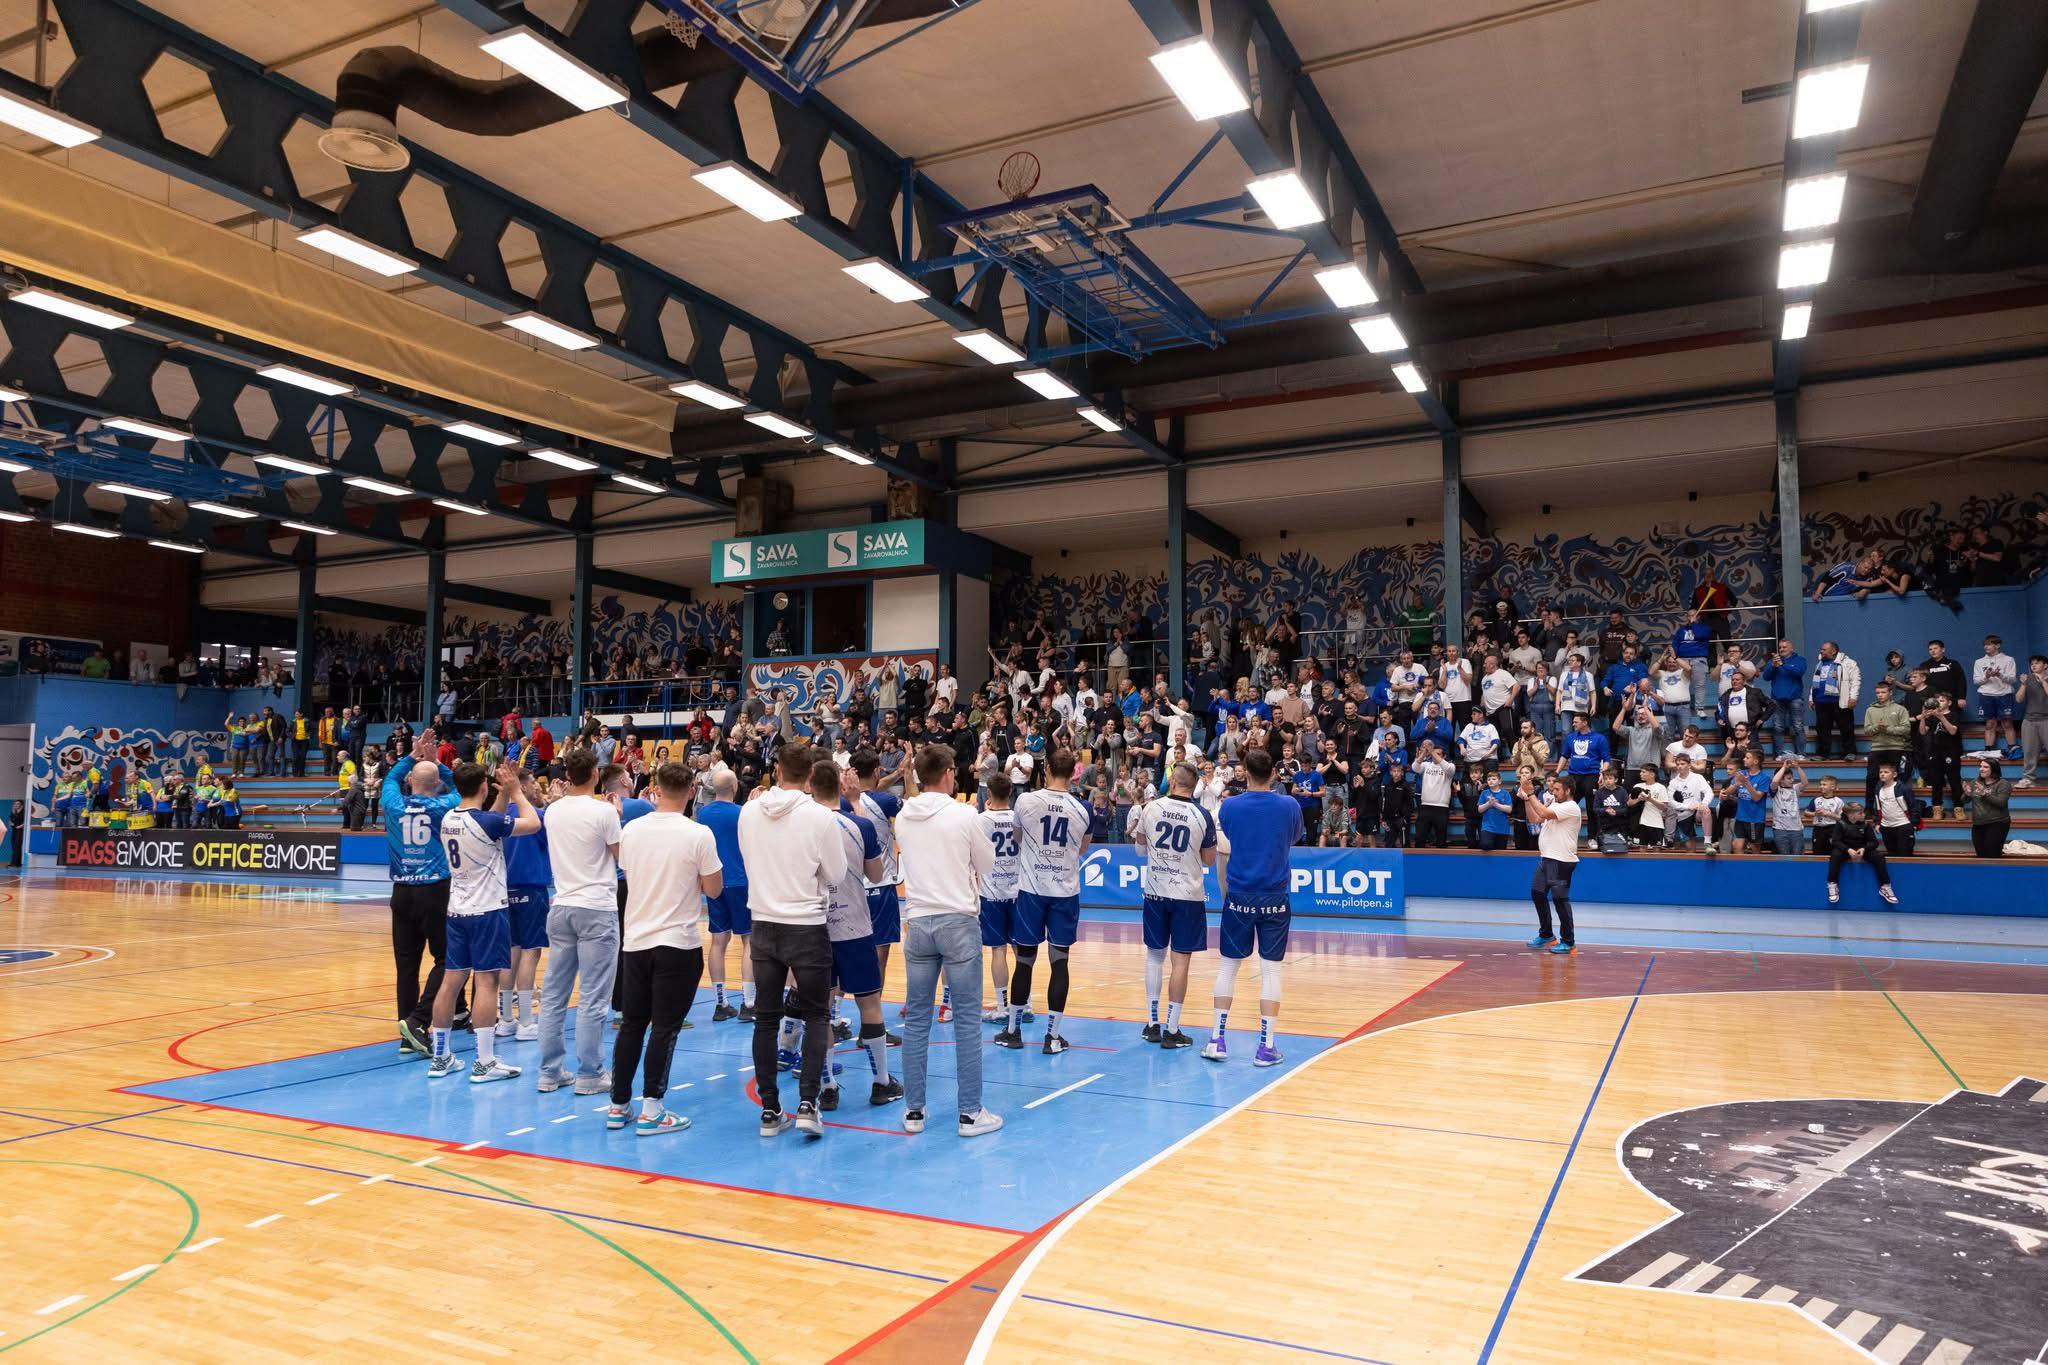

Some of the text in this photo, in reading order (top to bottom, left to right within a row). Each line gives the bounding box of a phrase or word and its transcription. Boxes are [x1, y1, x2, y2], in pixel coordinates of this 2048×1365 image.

[757, 543, 798, 561] SAVA
[863, 532, 909, 551] SAVA
[757, 560, 799, 569] ZAVAROVALNICA
[863, 550, 909, 559] ZAVAROVALNICA
[1048, 804, 1063, 813] LEVC
[1162, 810, 1188, 822] SVEČKO
[398, 814, 431, 845] 16
[1040, 815, 1069, 847] 14
[1155, 821, 1191, 852] 20
[447, 838, 462, 869] 8
[991, 831, 1020, 857] 23
[66, 840, 337, 871] BAGS&MORE OFFICE&MORE
[1290, 869, 1392, 896] PILOT
[1315, 897, 1393, 909] www.pilotpen.si
